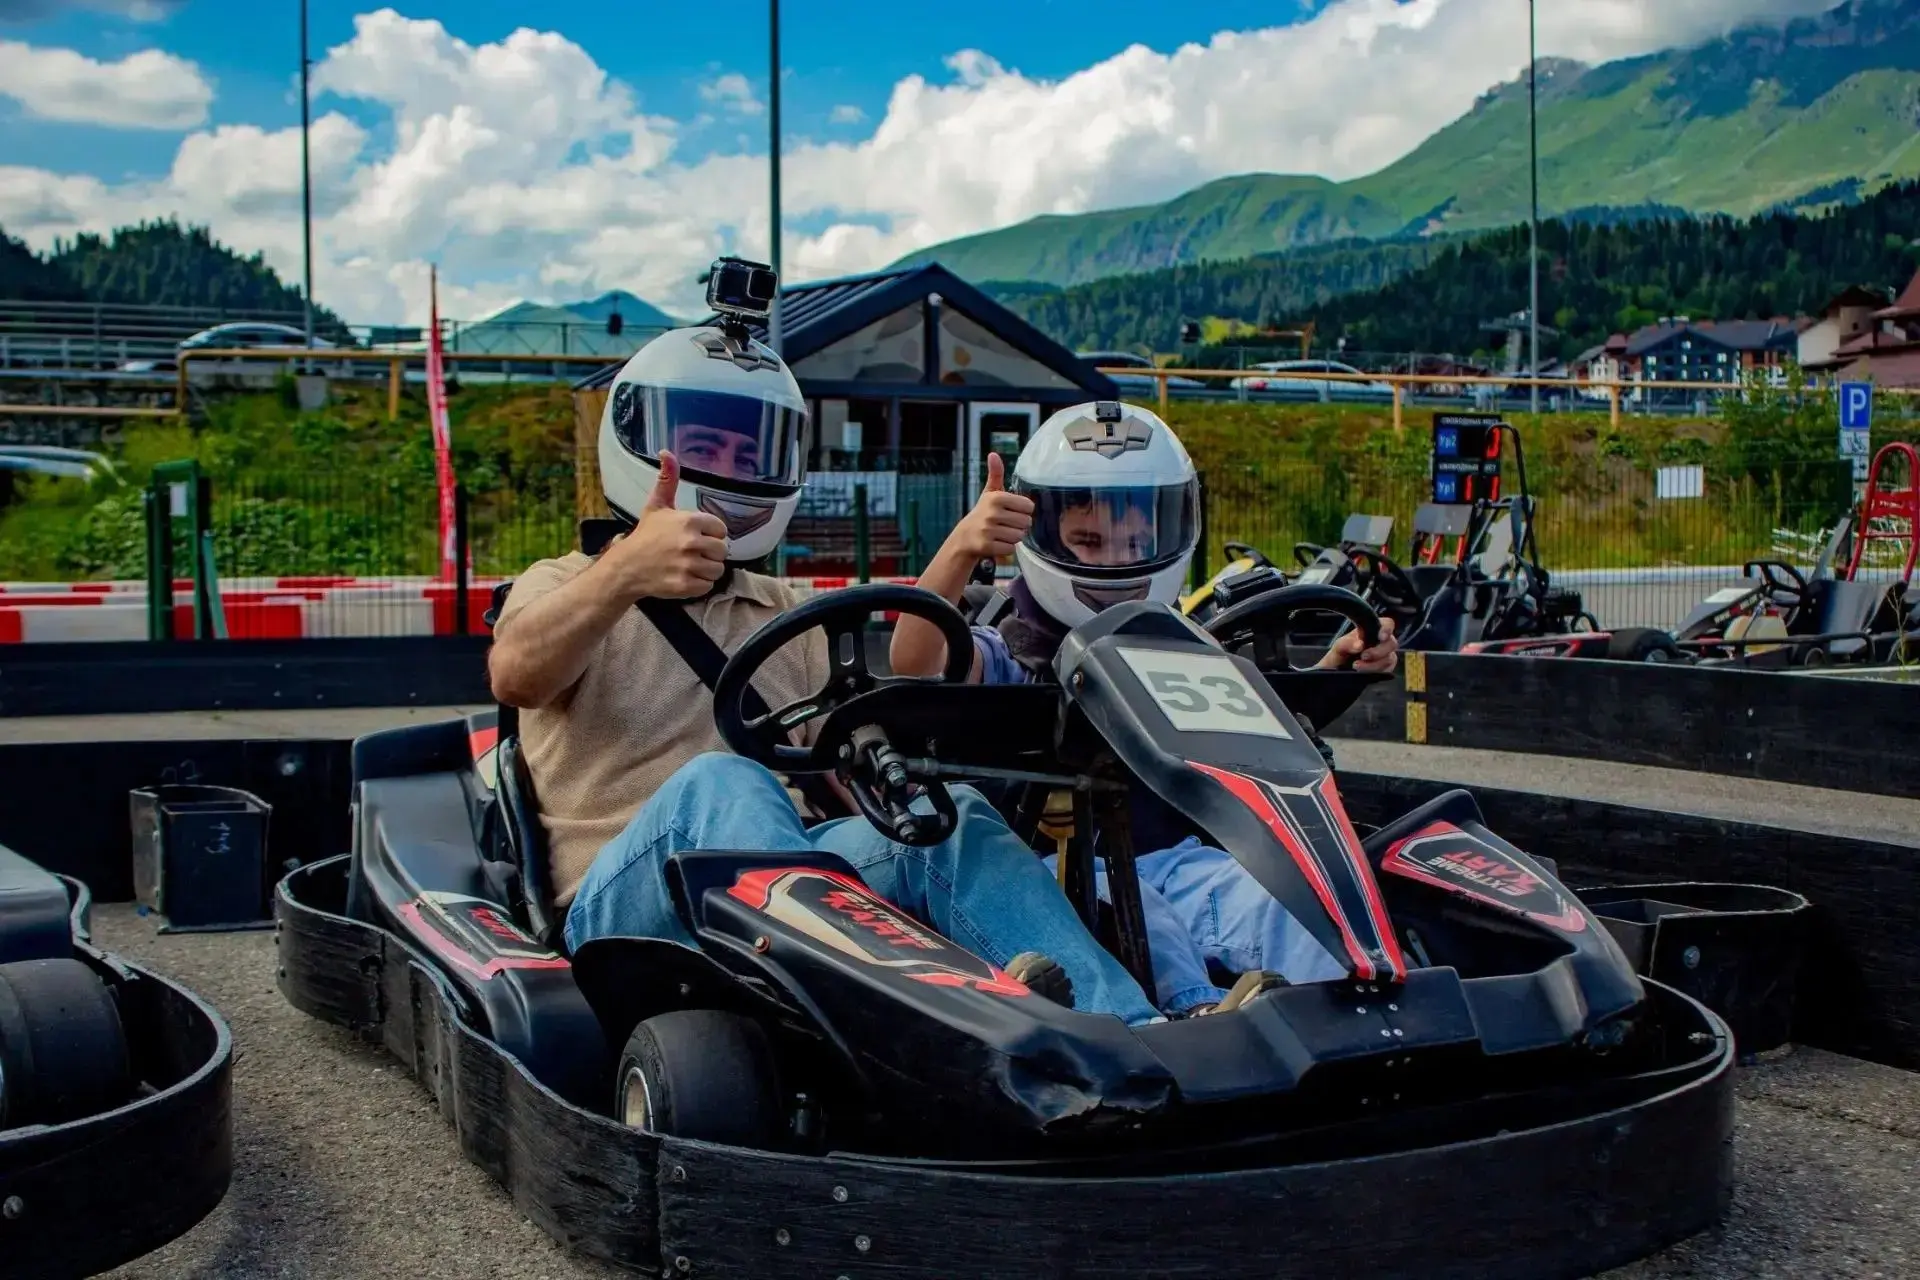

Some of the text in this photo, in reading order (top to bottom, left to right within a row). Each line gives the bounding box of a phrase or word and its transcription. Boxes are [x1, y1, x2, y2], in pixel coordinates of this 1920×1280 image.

[1850, 388, 1867, 423] P
[1146, 670, 1264, 718] 53
[1426, 856, 1532, 896] EXTREME
[1441, 850, 1540, 894] KART
[819, 891, 926, 950] KART
[840, 891, 945, 949] EXTREME
